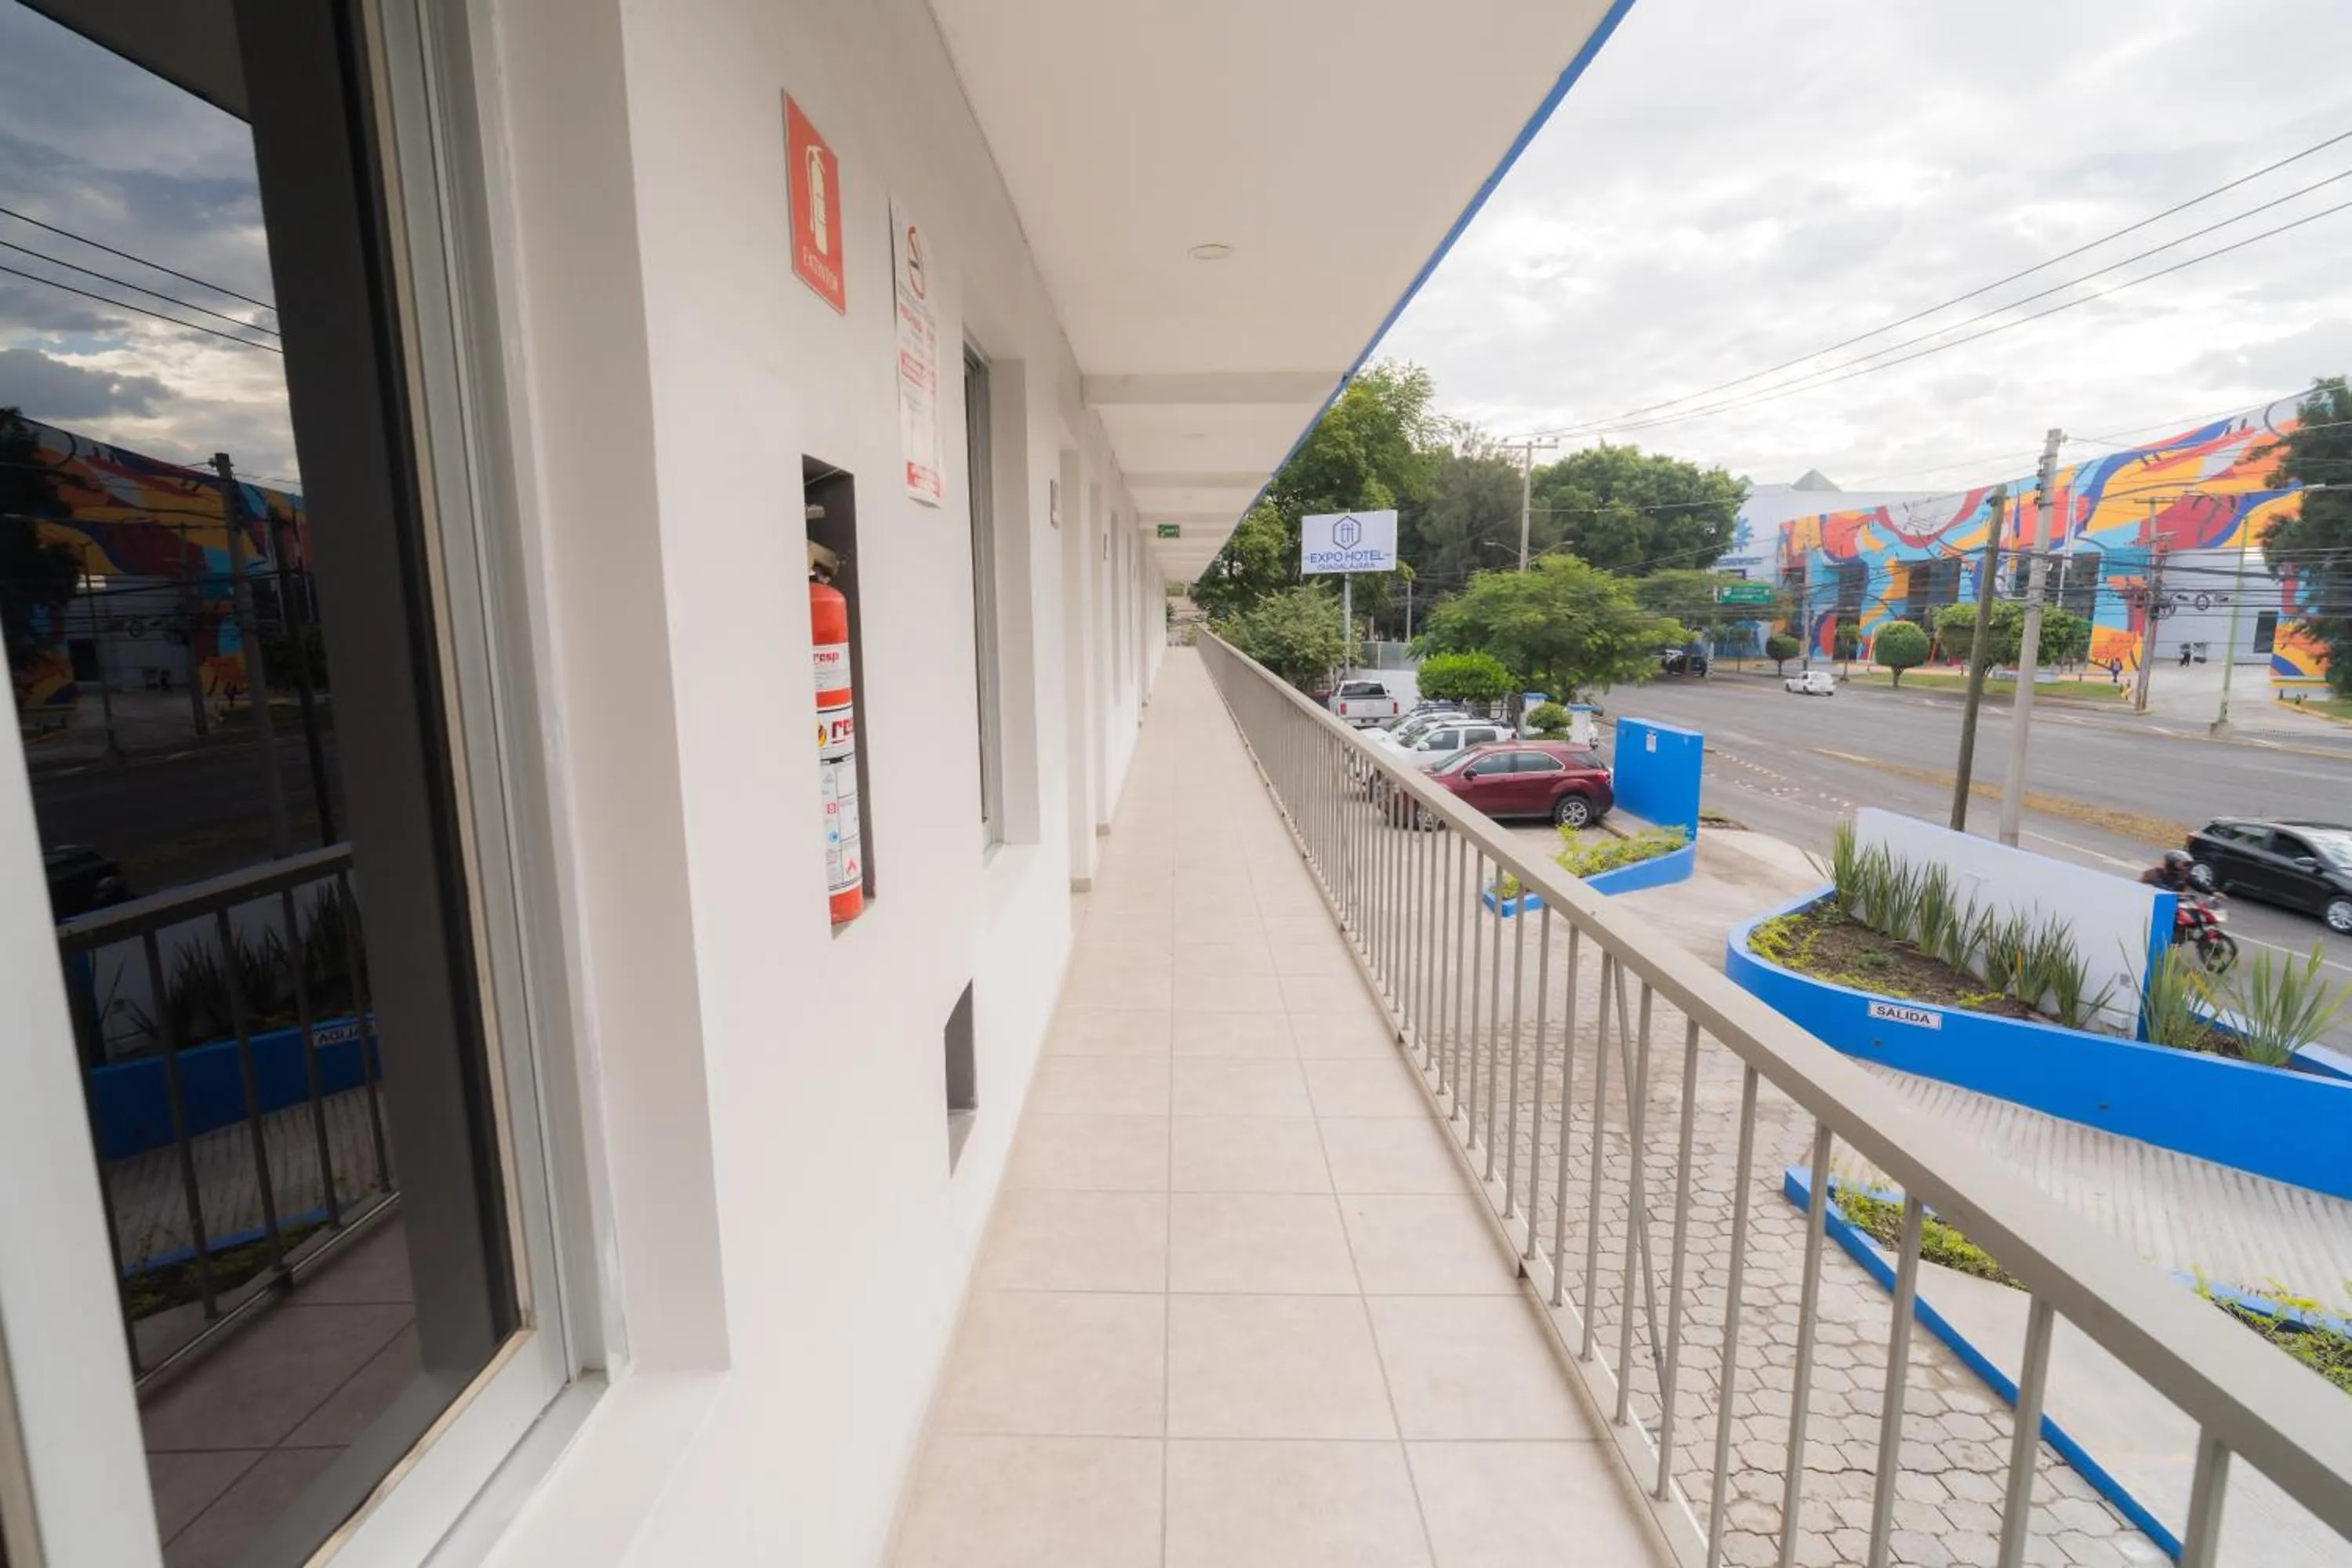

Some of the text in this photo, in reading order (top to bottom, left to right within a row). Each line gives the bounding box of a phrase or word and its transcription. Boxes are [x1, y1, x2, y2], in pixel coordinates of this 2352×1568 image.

[1310, 550, 1385, 564] EXPO HOTEL
[1876, 1006, 1930, 1024] SALIDA
